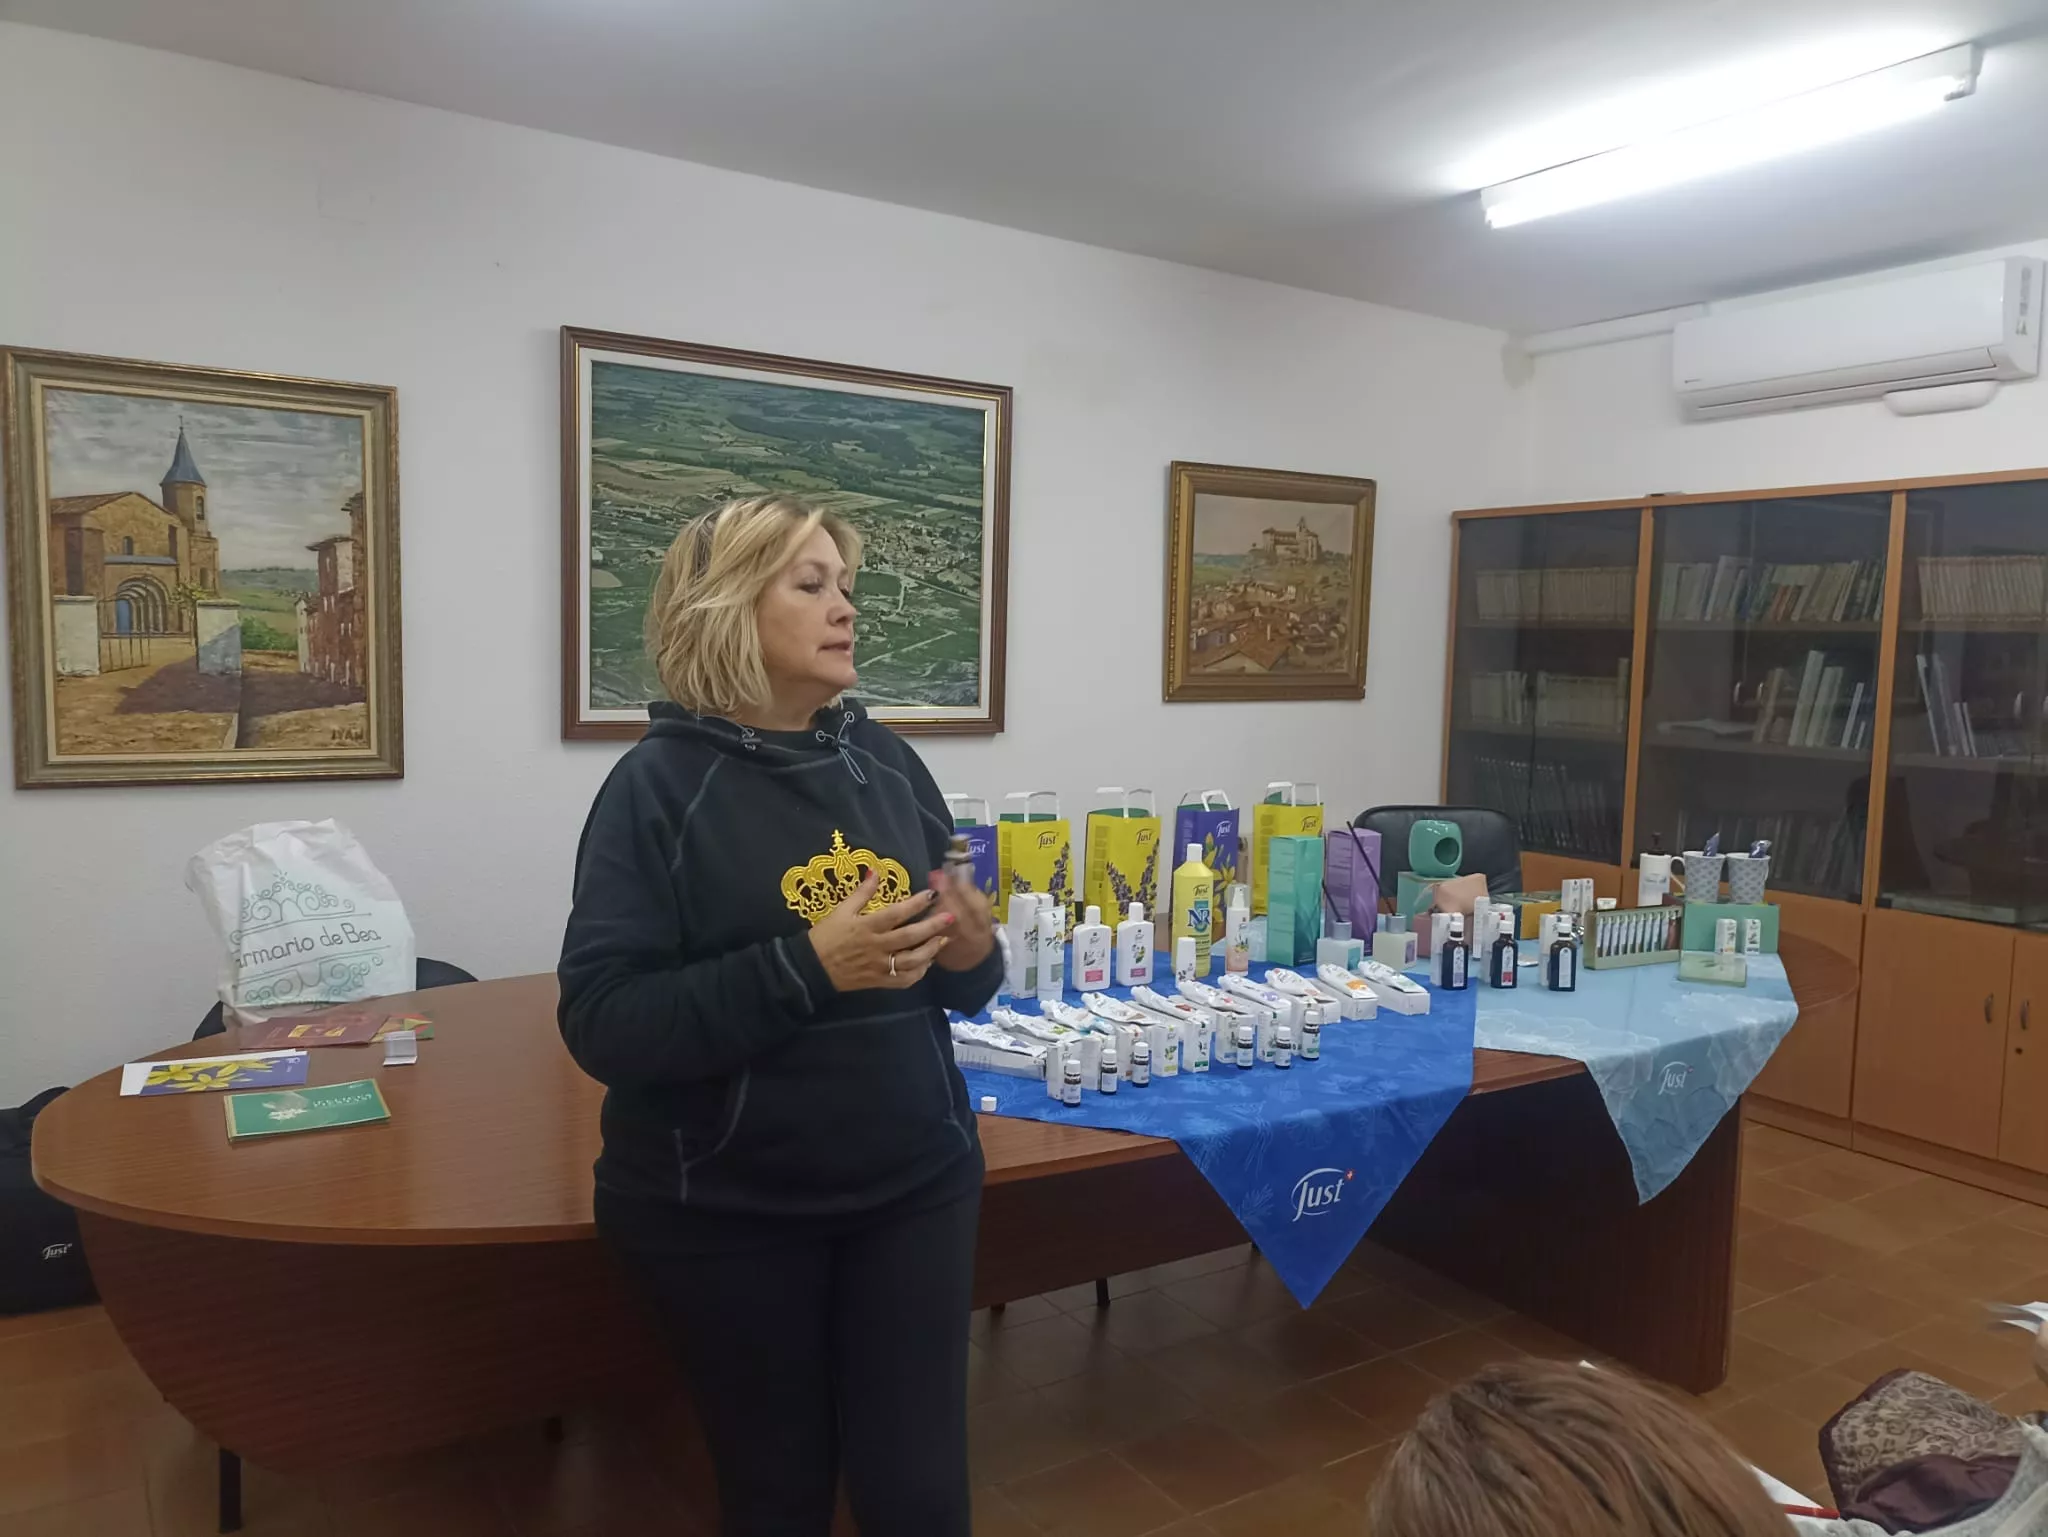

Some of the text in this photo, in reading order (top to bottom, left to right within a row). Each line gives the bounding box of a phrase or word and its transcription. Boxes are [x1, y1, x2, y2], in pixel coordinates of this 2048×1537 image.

[1216, 820, 1232, 838] Just
[1301, 815, 1320, 832] Just
[1037, 831, 1058, 849] Just
[1136, 828, 1154, 846] Just
[319, 925, 344, 947] de
[340, 922, 382, 944] Bea
[1659, 1061, 1688, 1095] Just
[1291, 1168, 1346, 1222] Just
[43, 1243, 69, 1260] Just
